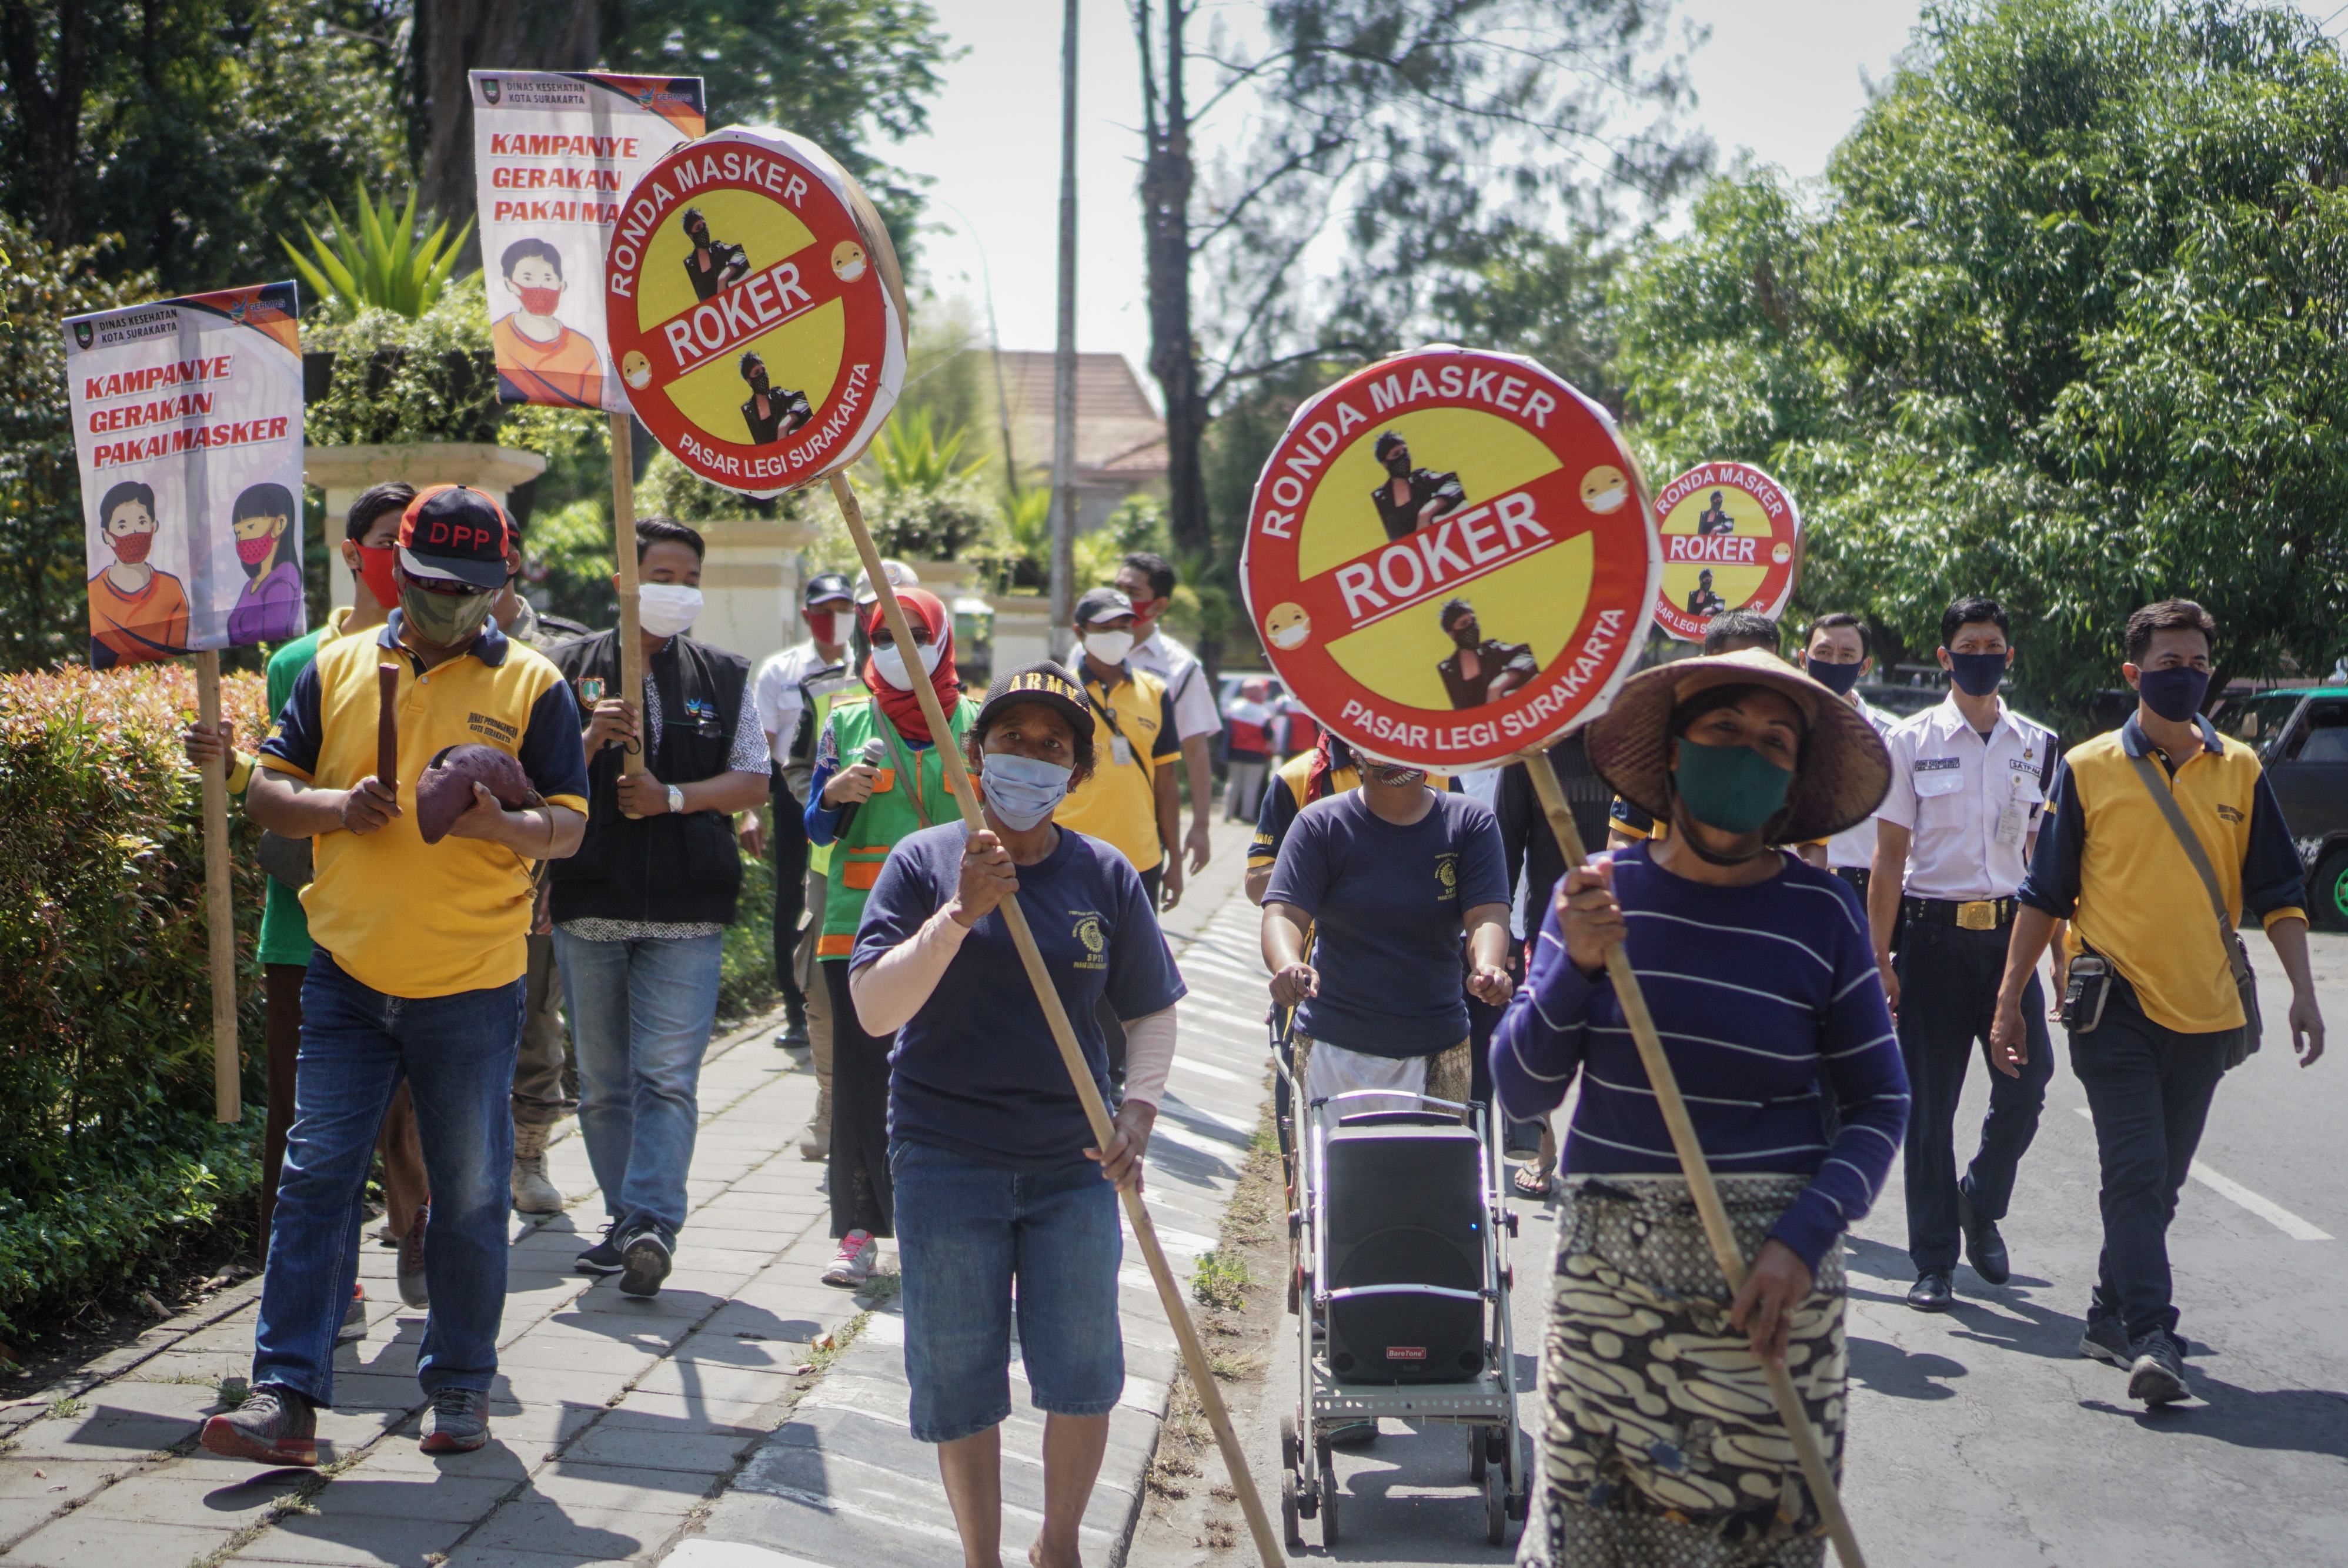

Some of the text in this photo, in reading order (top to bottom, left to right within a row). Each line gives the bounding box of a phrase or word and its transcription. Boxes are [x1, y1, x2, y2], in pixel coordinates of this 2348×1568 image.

[507, 82, 585, 93] DINAS KESEHATAN
[509, 94, 585, 105] KOTA SURAKARTA
[656, 93, 693, 102] GERMAS
[490, 133, 639, 159] KAMPANYE
[492, 167, 622, 192] GERAKAN
[494, 200, 576, 222] PAKAI
[611, 152, 807, 297] RONDA MASKER
[248, 299, 286, 311] GERMAS
[664, 262, 812, 366] ROKER
[99, 309, 177, 331] DINAS KESEHATAN
[102, 322, 176, 343] KOTA SURAKARTA
[85, 355, 232, 400] KAMPANYE
[89, 392, 213, 434] GERAKAN
[679, 362, 870, 478] PASAR LEGI SURAKARTA
[93, 416, 288, 468] PAKAI MASKER
[1262, 365, 1557, 539] RONDA MASKER
[1656, 467, 1782, 518] RONDA MASKER
[429, 522, 490, 551] DPP
[1670, 536, 1755, 561] ROKER
[1334, 492, 1549, 618] ROKER
[1655, 601, 1674, 623] SAR
[1673, 617, 1698, 633] LEGI
[1008, 673, 1079, 700] ARMY
[1341, 609, 1624, 750] PASAR LEGI SURAKARTA
[467, 712, 484, 724] DINAS
[469, 724, 510, 744] KOTA SURAKARTA
[2013, 761, 2040, 776] SATPAM
